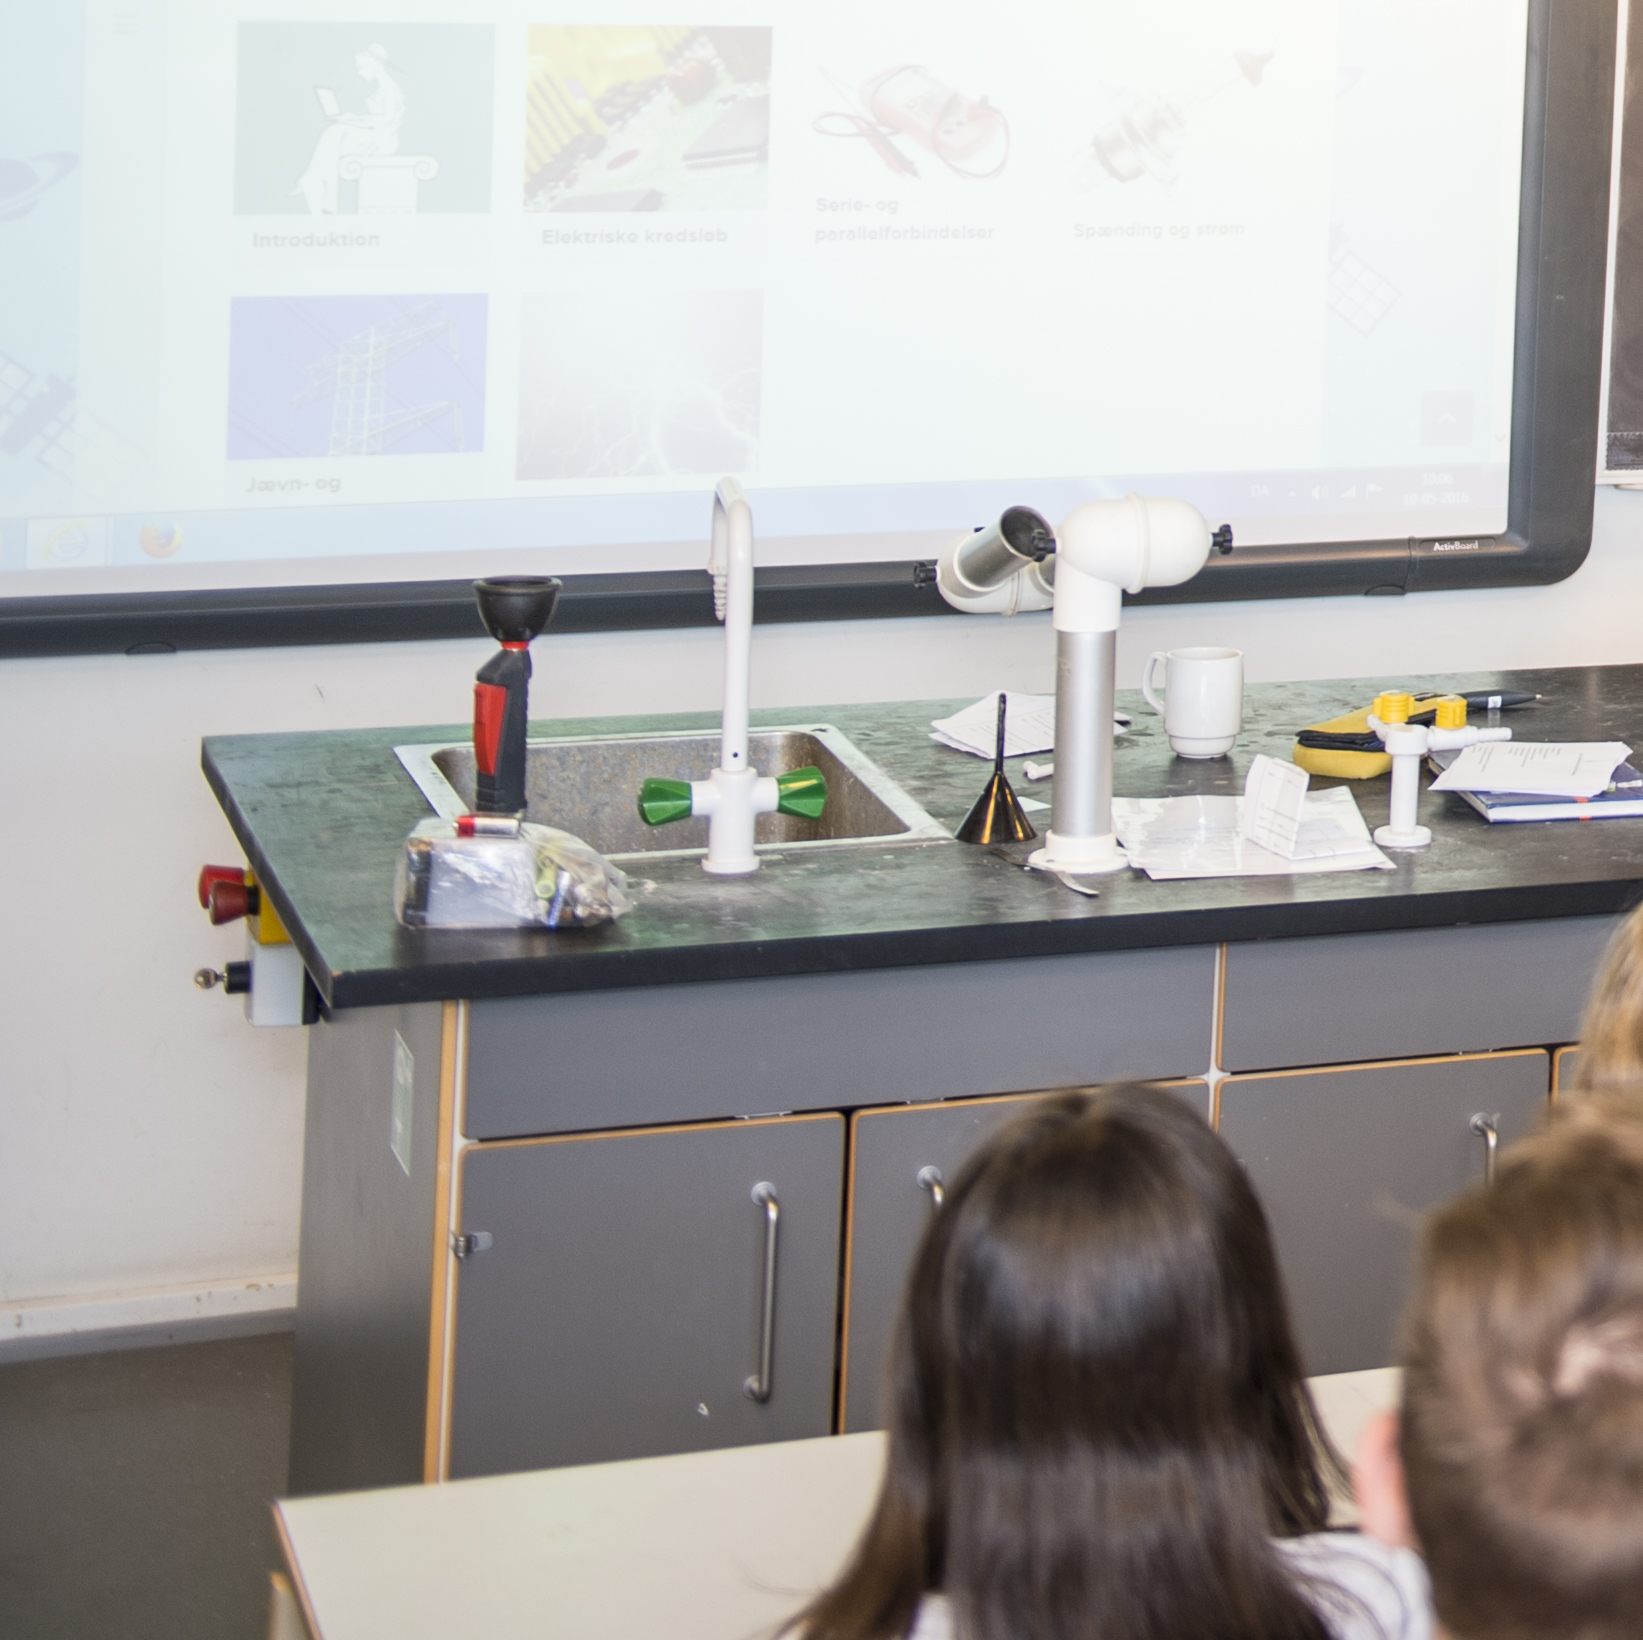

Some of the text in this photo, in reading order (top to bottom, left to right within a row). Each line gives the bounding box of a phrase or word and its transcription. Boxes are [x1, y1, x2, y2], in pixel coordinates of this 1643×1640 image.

[815, 197, 899, 215] Serie- og
[251, 229, 381, 248] Introduktion
[541, 226, 729, 246] Elektriske kredsløb
[814, 224, 996, 244] parallelforbindelser
[245, 476, 341, 493] Jævn- og
